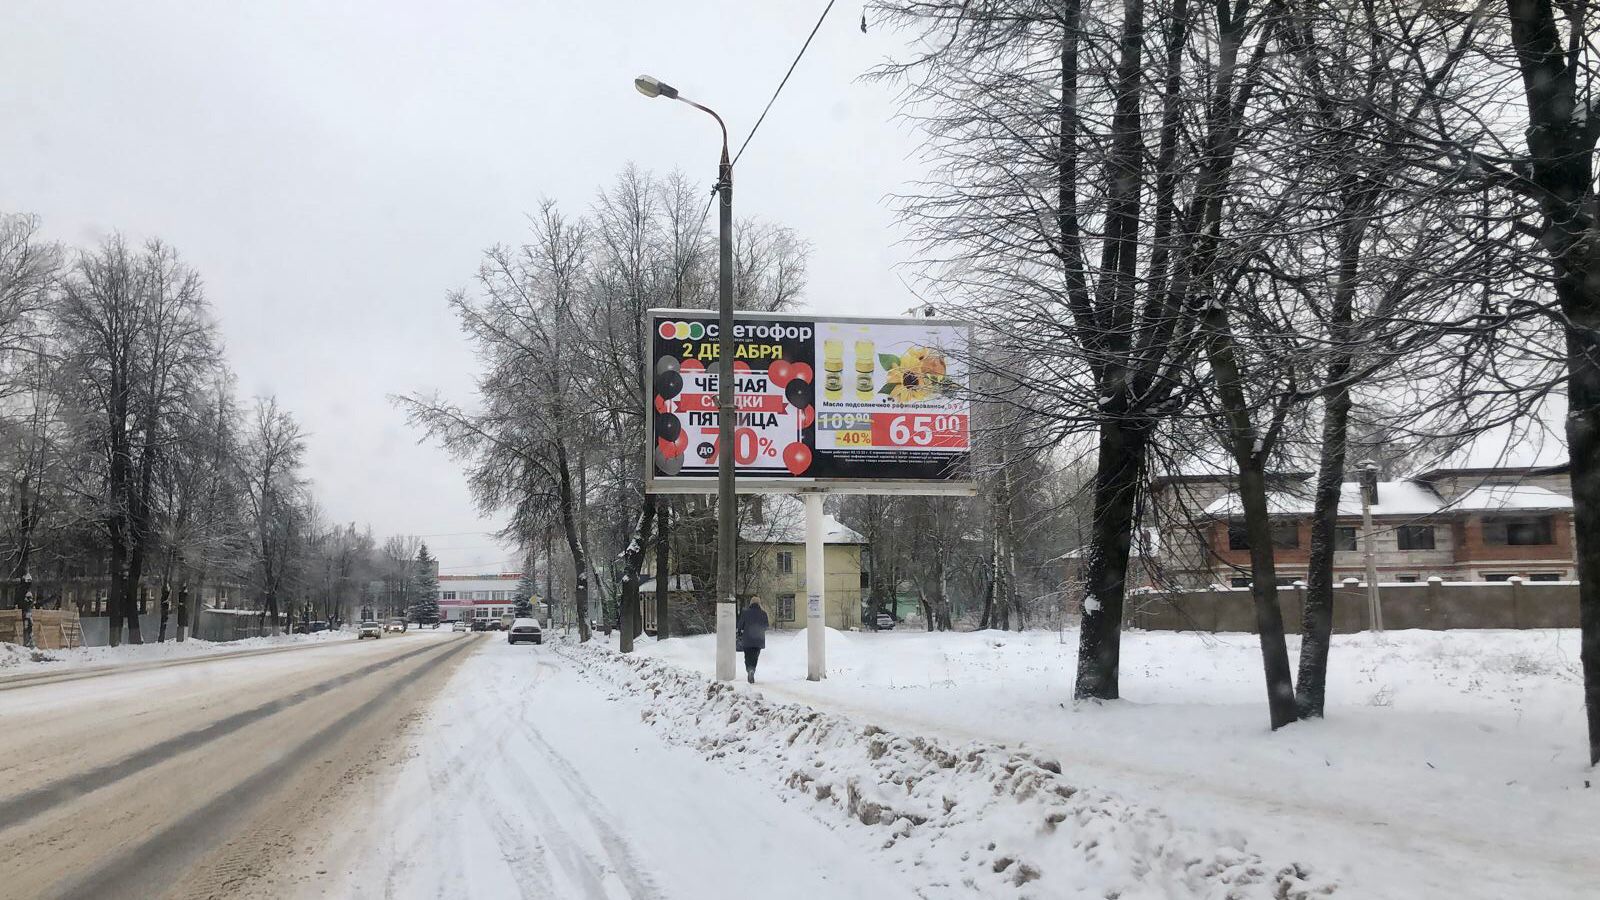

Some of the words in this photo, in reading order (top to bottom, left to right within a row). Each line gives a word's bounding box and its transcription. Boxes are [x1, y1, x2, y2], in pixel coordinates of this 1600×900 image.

[706, 323, 812, 342] сетофор
[682, 343, 693, 357] 2
[697, 343, 783, 360] ДЕАБРЯ
[694, 374, 767, 393] ЧЁНАЯ
[689, 412, 779, 430] ПЯТИЦА
[836, 432, 871, 444] -40%
[699, 446, 714, 456] до
